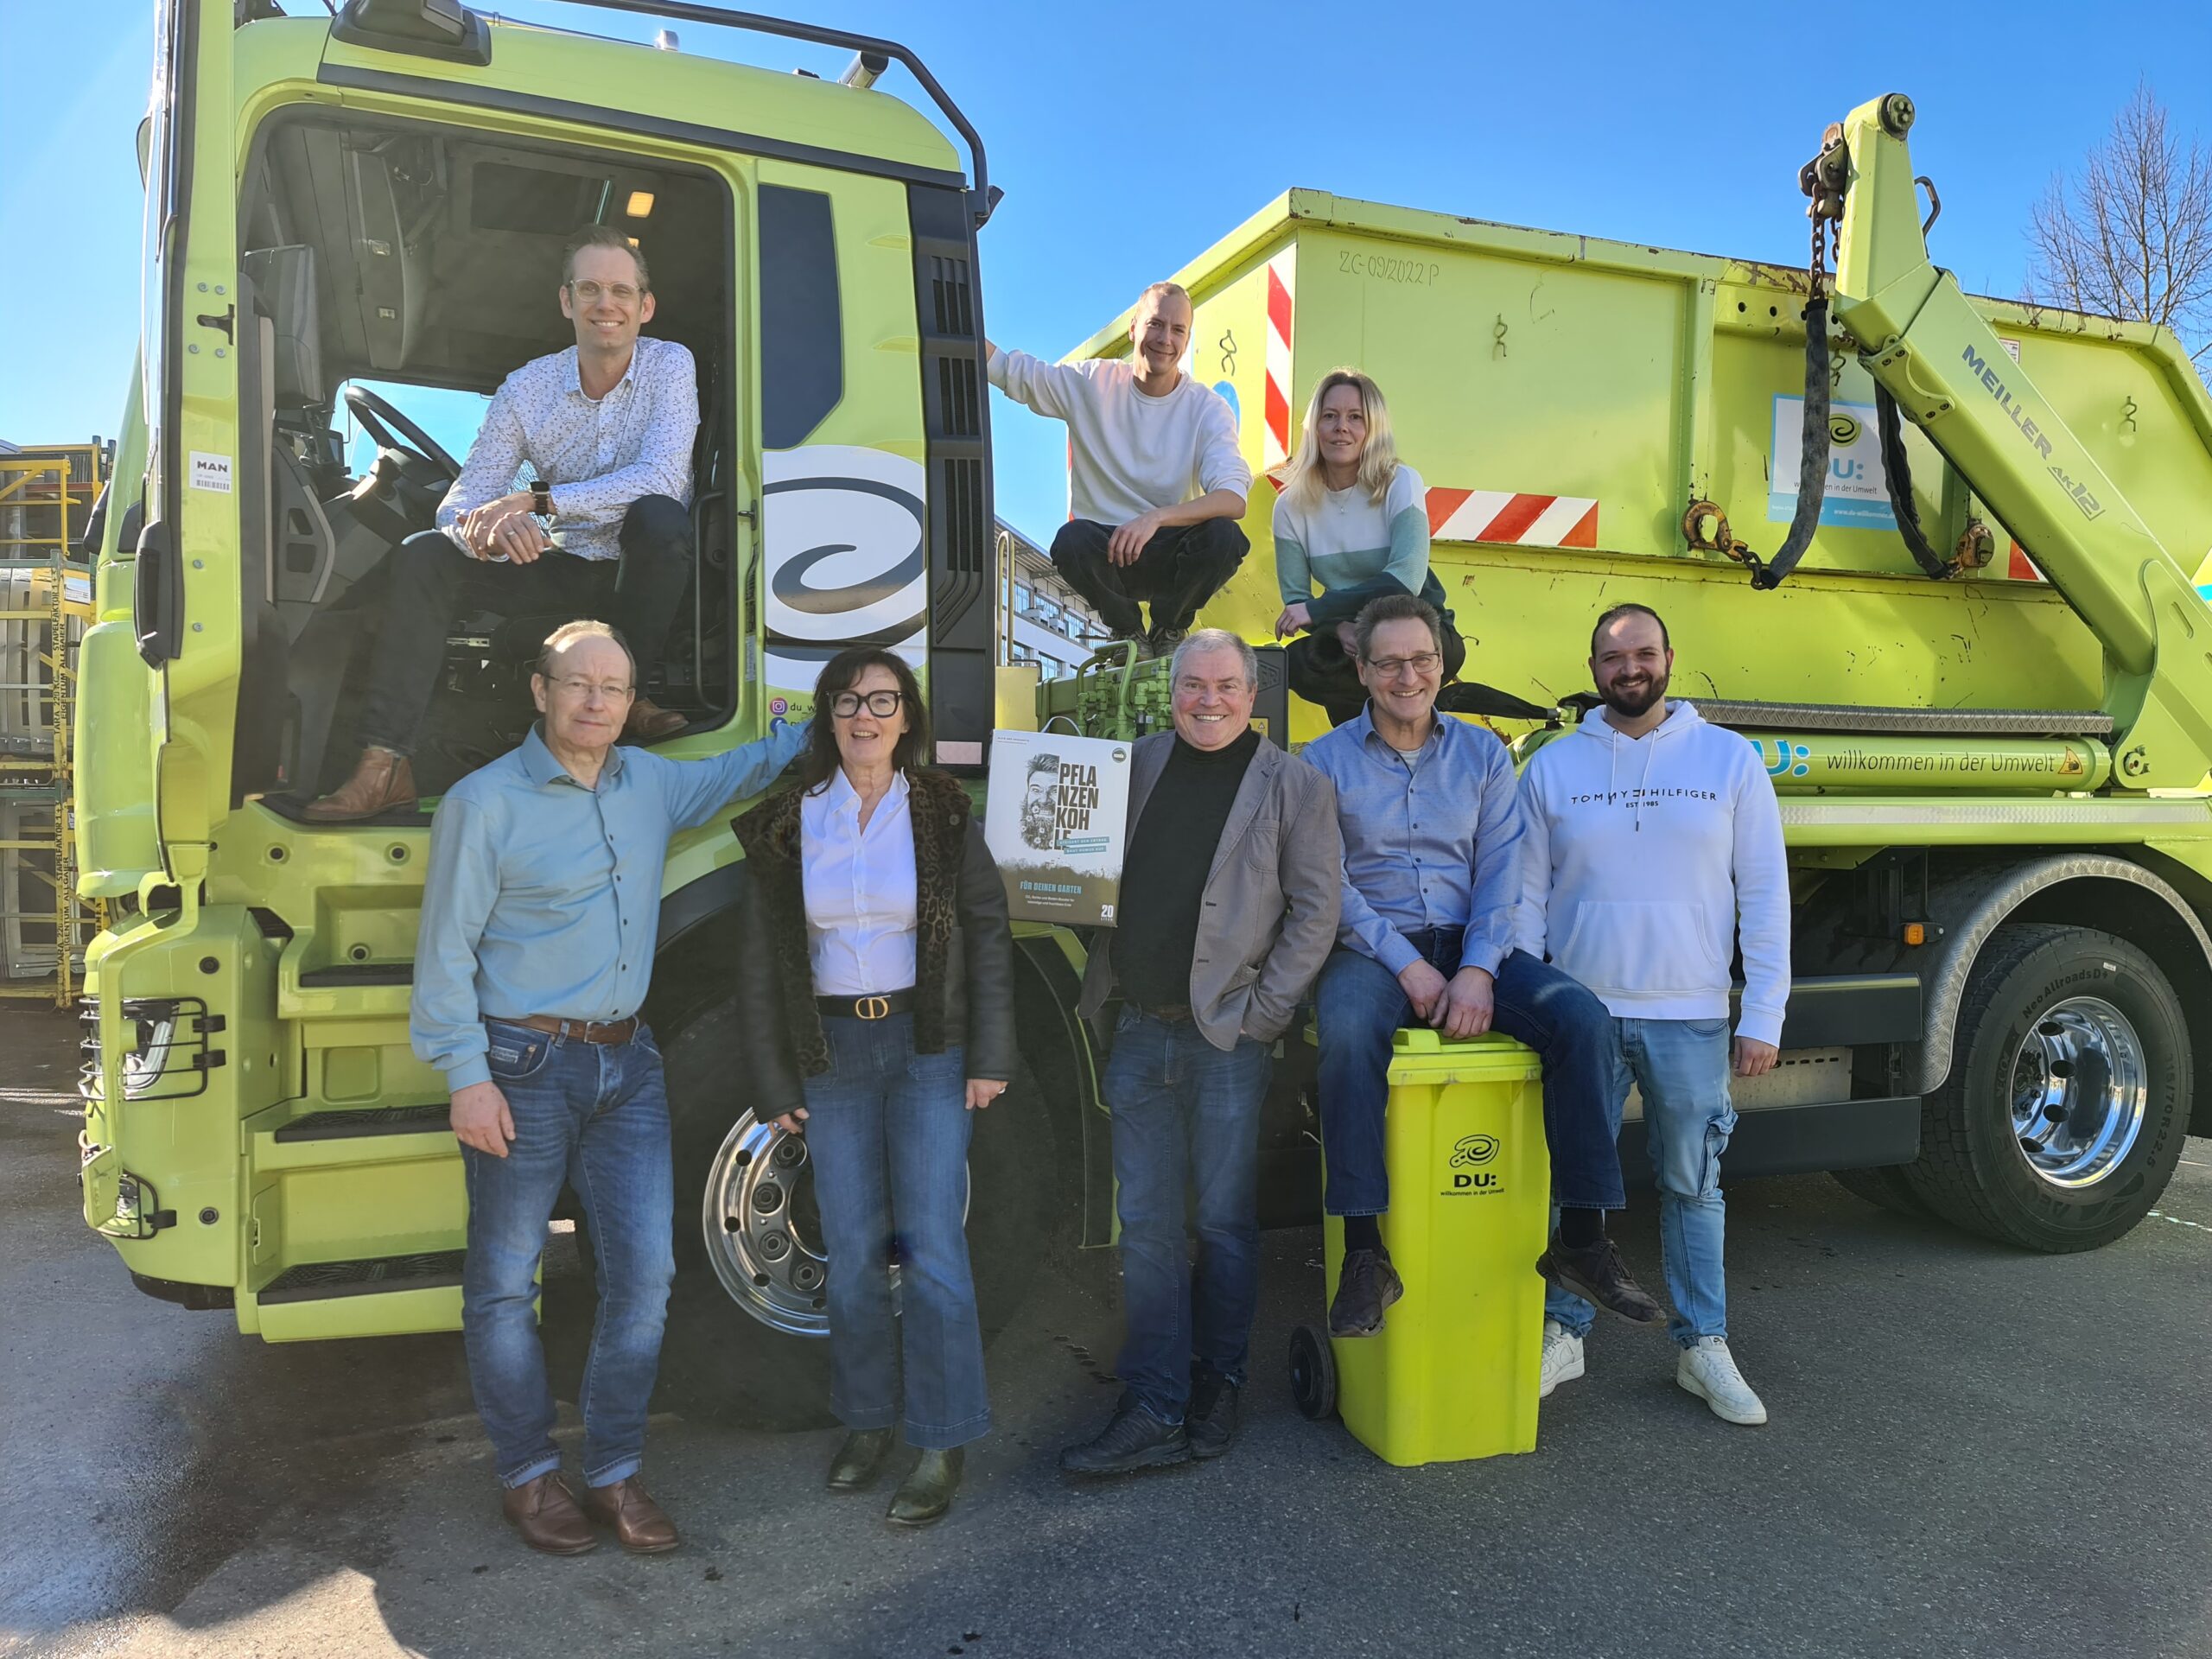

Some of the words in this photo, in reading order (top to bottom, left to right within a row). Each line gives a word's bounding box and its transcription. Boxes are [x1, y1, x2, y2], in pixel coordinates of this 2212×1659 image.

[1961, 344, 2053, 461] MEILLER
[197, 461, 227, 473] MAN
[1827, 457, 1864, 480] U:
[1840, 484, 1852, 493] der
[1853, 485, 1878, 494] Umwelt
[52, 592, 60, 651] STAPELFAKTOR
[1749, 740, 1810, 777] U:
[1827, 749, 1933, 771] willkommen
[1939, 753, 1955, 771] in
[1960, 752, 1986, 772] der
[1991, 753, 2055, 772] Umwelt
[1059, 763, 1097, 787] PFLA
[1058, 785, 1099, 809] NZEN
[1650, 788, 1717, 801] HILFIGER
[1055, 806, 1090, 830] KOH
[1020, 880, 1033, 891] FÜR
[1033, 881, 1057, 893] DEINEN
[1057, 884, 1082, 894] GARTEN
[1101, 904, 1114, 918] 20
[2044, 969, 2092, 998] Allroads
[1453, 1173, 1497, 1188] DU:
